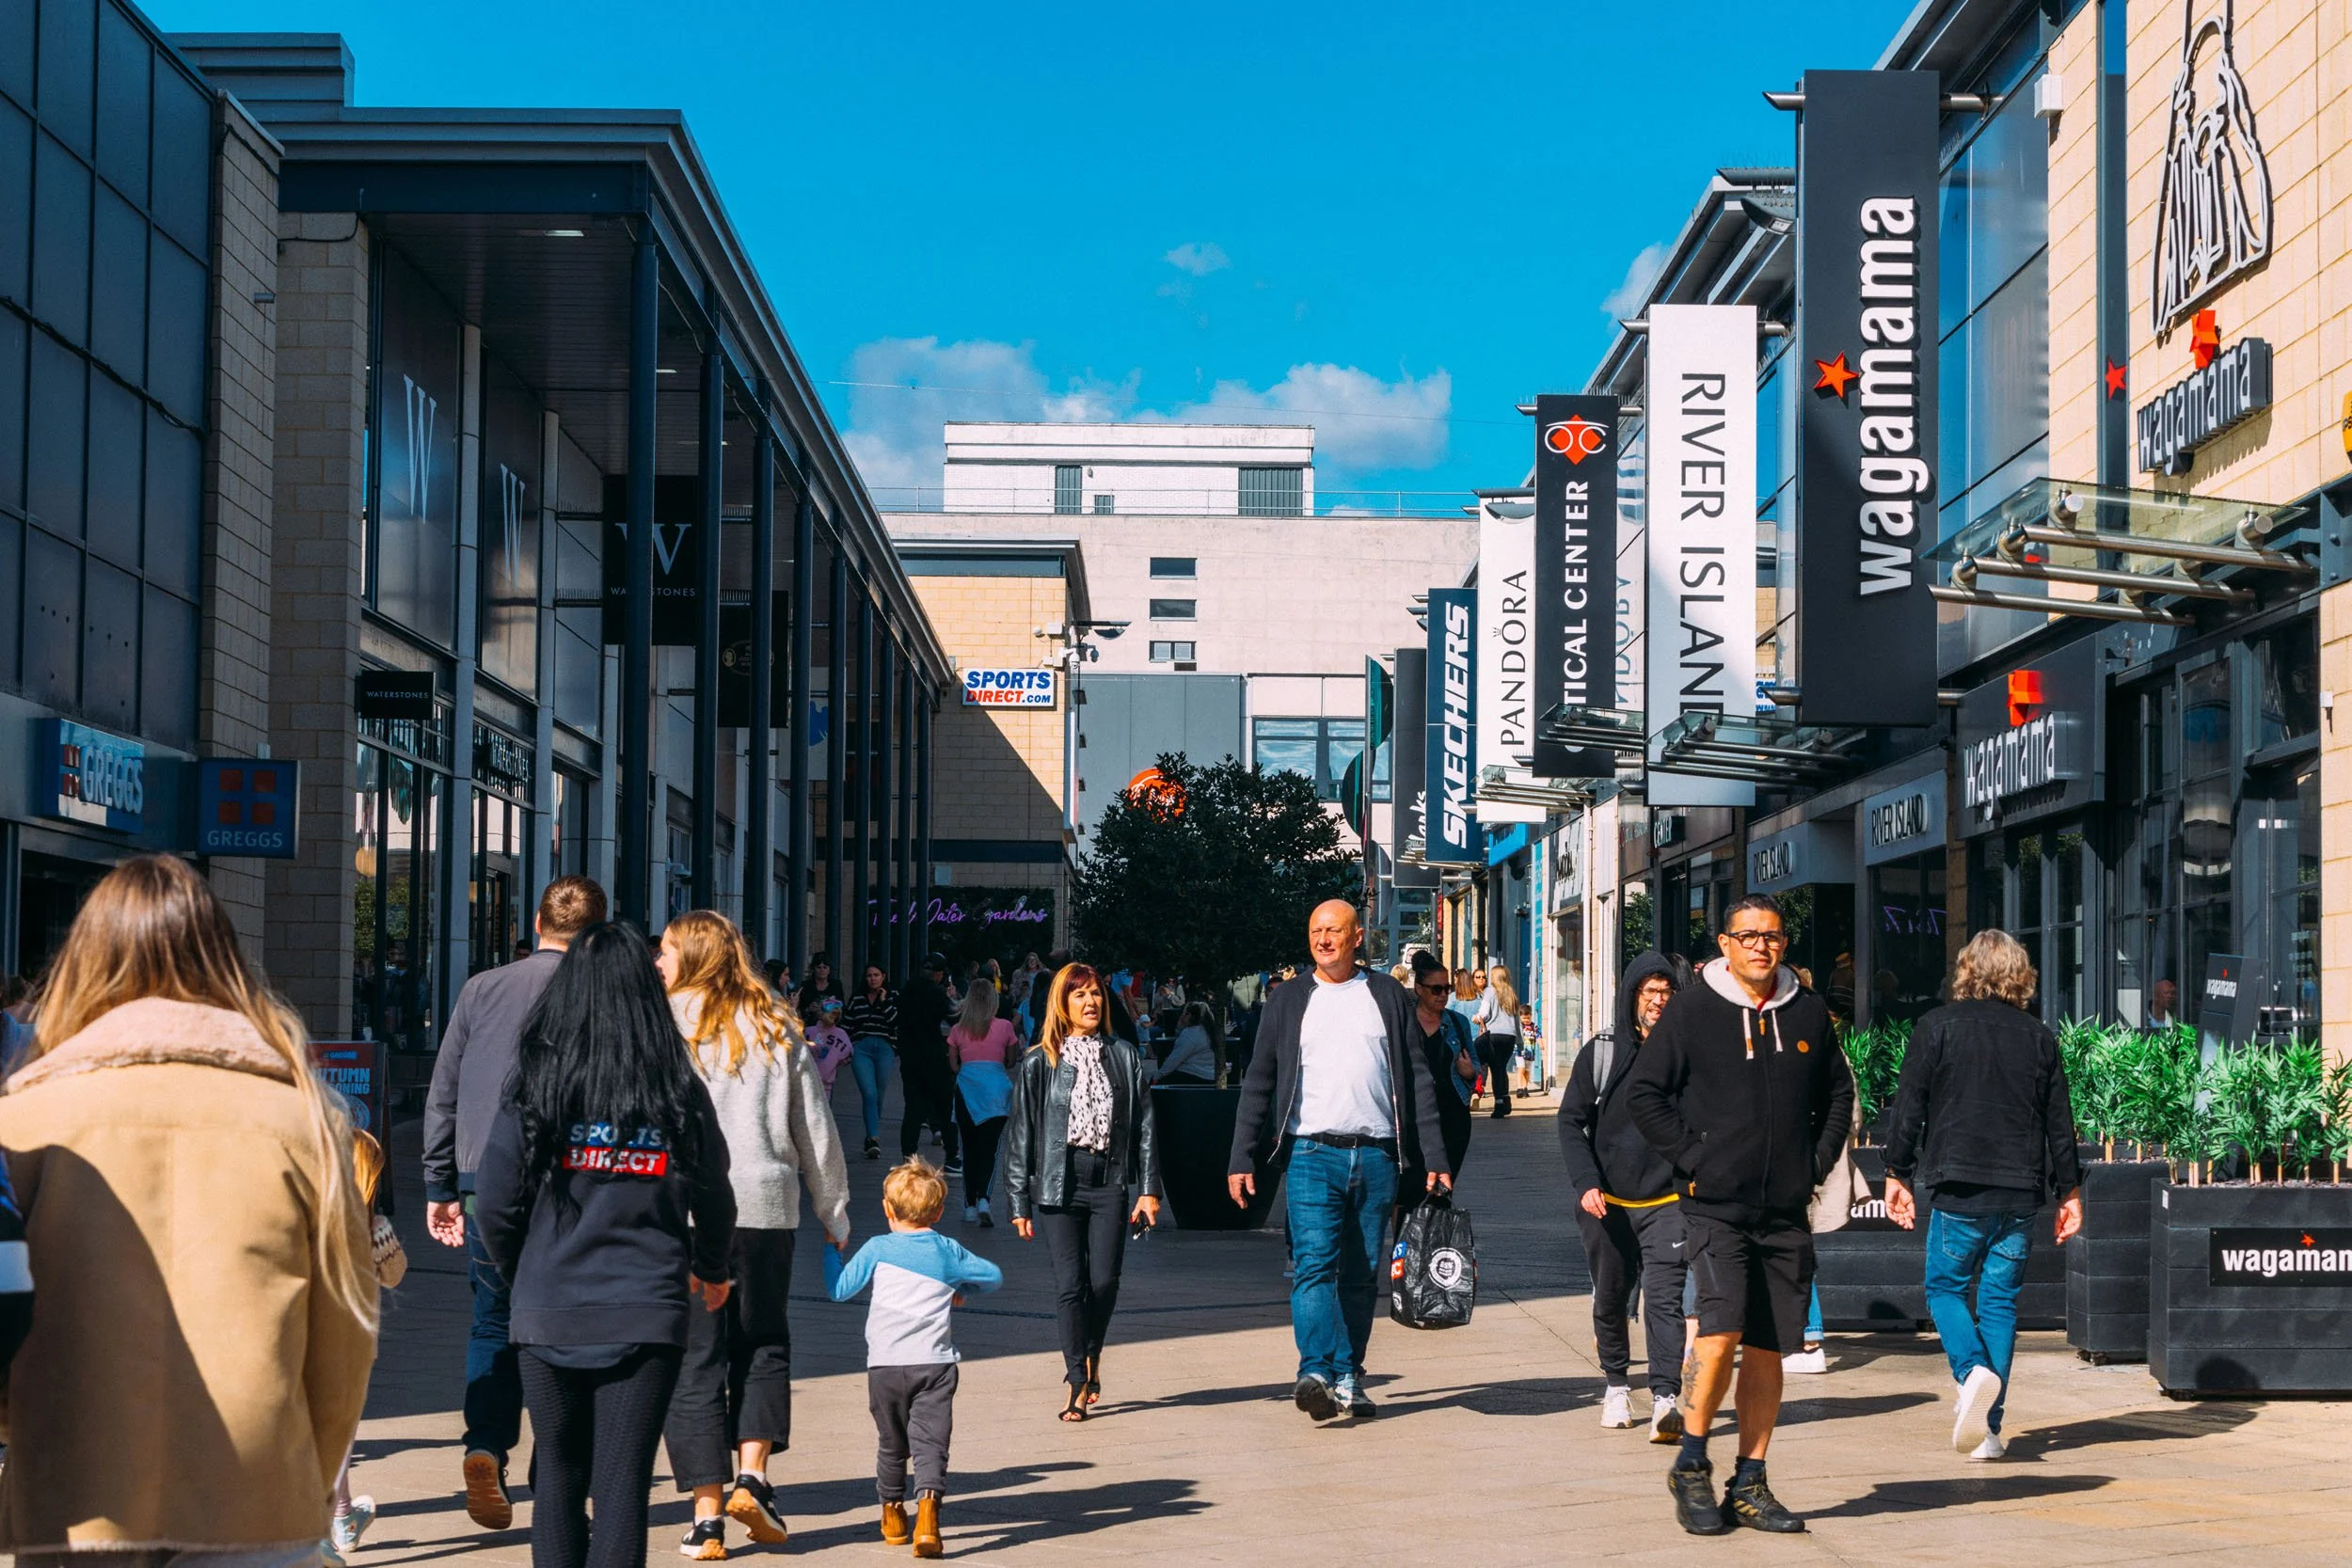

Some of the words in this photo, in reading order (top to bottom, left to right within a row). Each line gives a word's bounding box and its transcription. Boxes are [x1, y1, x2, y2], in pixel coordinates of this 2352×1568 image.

[1859, 196, 1930, 596] wagamama
[2138, 340, 2251, 477] wagamama
[1681, 372, 1725, 521] RIVER
[1564, 481, 1589, 609] CENTER
[965, 671, 1051, 689] SPORTS
[1500, 570, 1527, 745] PANDORA
[366, 690, 429, 699] WATERSTONES
[1443, 601, 1469, 848] SKECHERS
[84, 744, 143, 815] GREGGS
[1964, 713, 2055, 820] wagamama
[207, 830, 283, 847] GREGGS
[1871, 804, 1894, 847] RIVER
[1895, 794, 1926, 840] ISLAND
[1754, 849, 1768, 884] RIVER
[1768, 843, 1791, 879] ISLAND
[2206, 979, 2237, 999] wagamama
[570, 1124, 662, 1147] SPOTS
